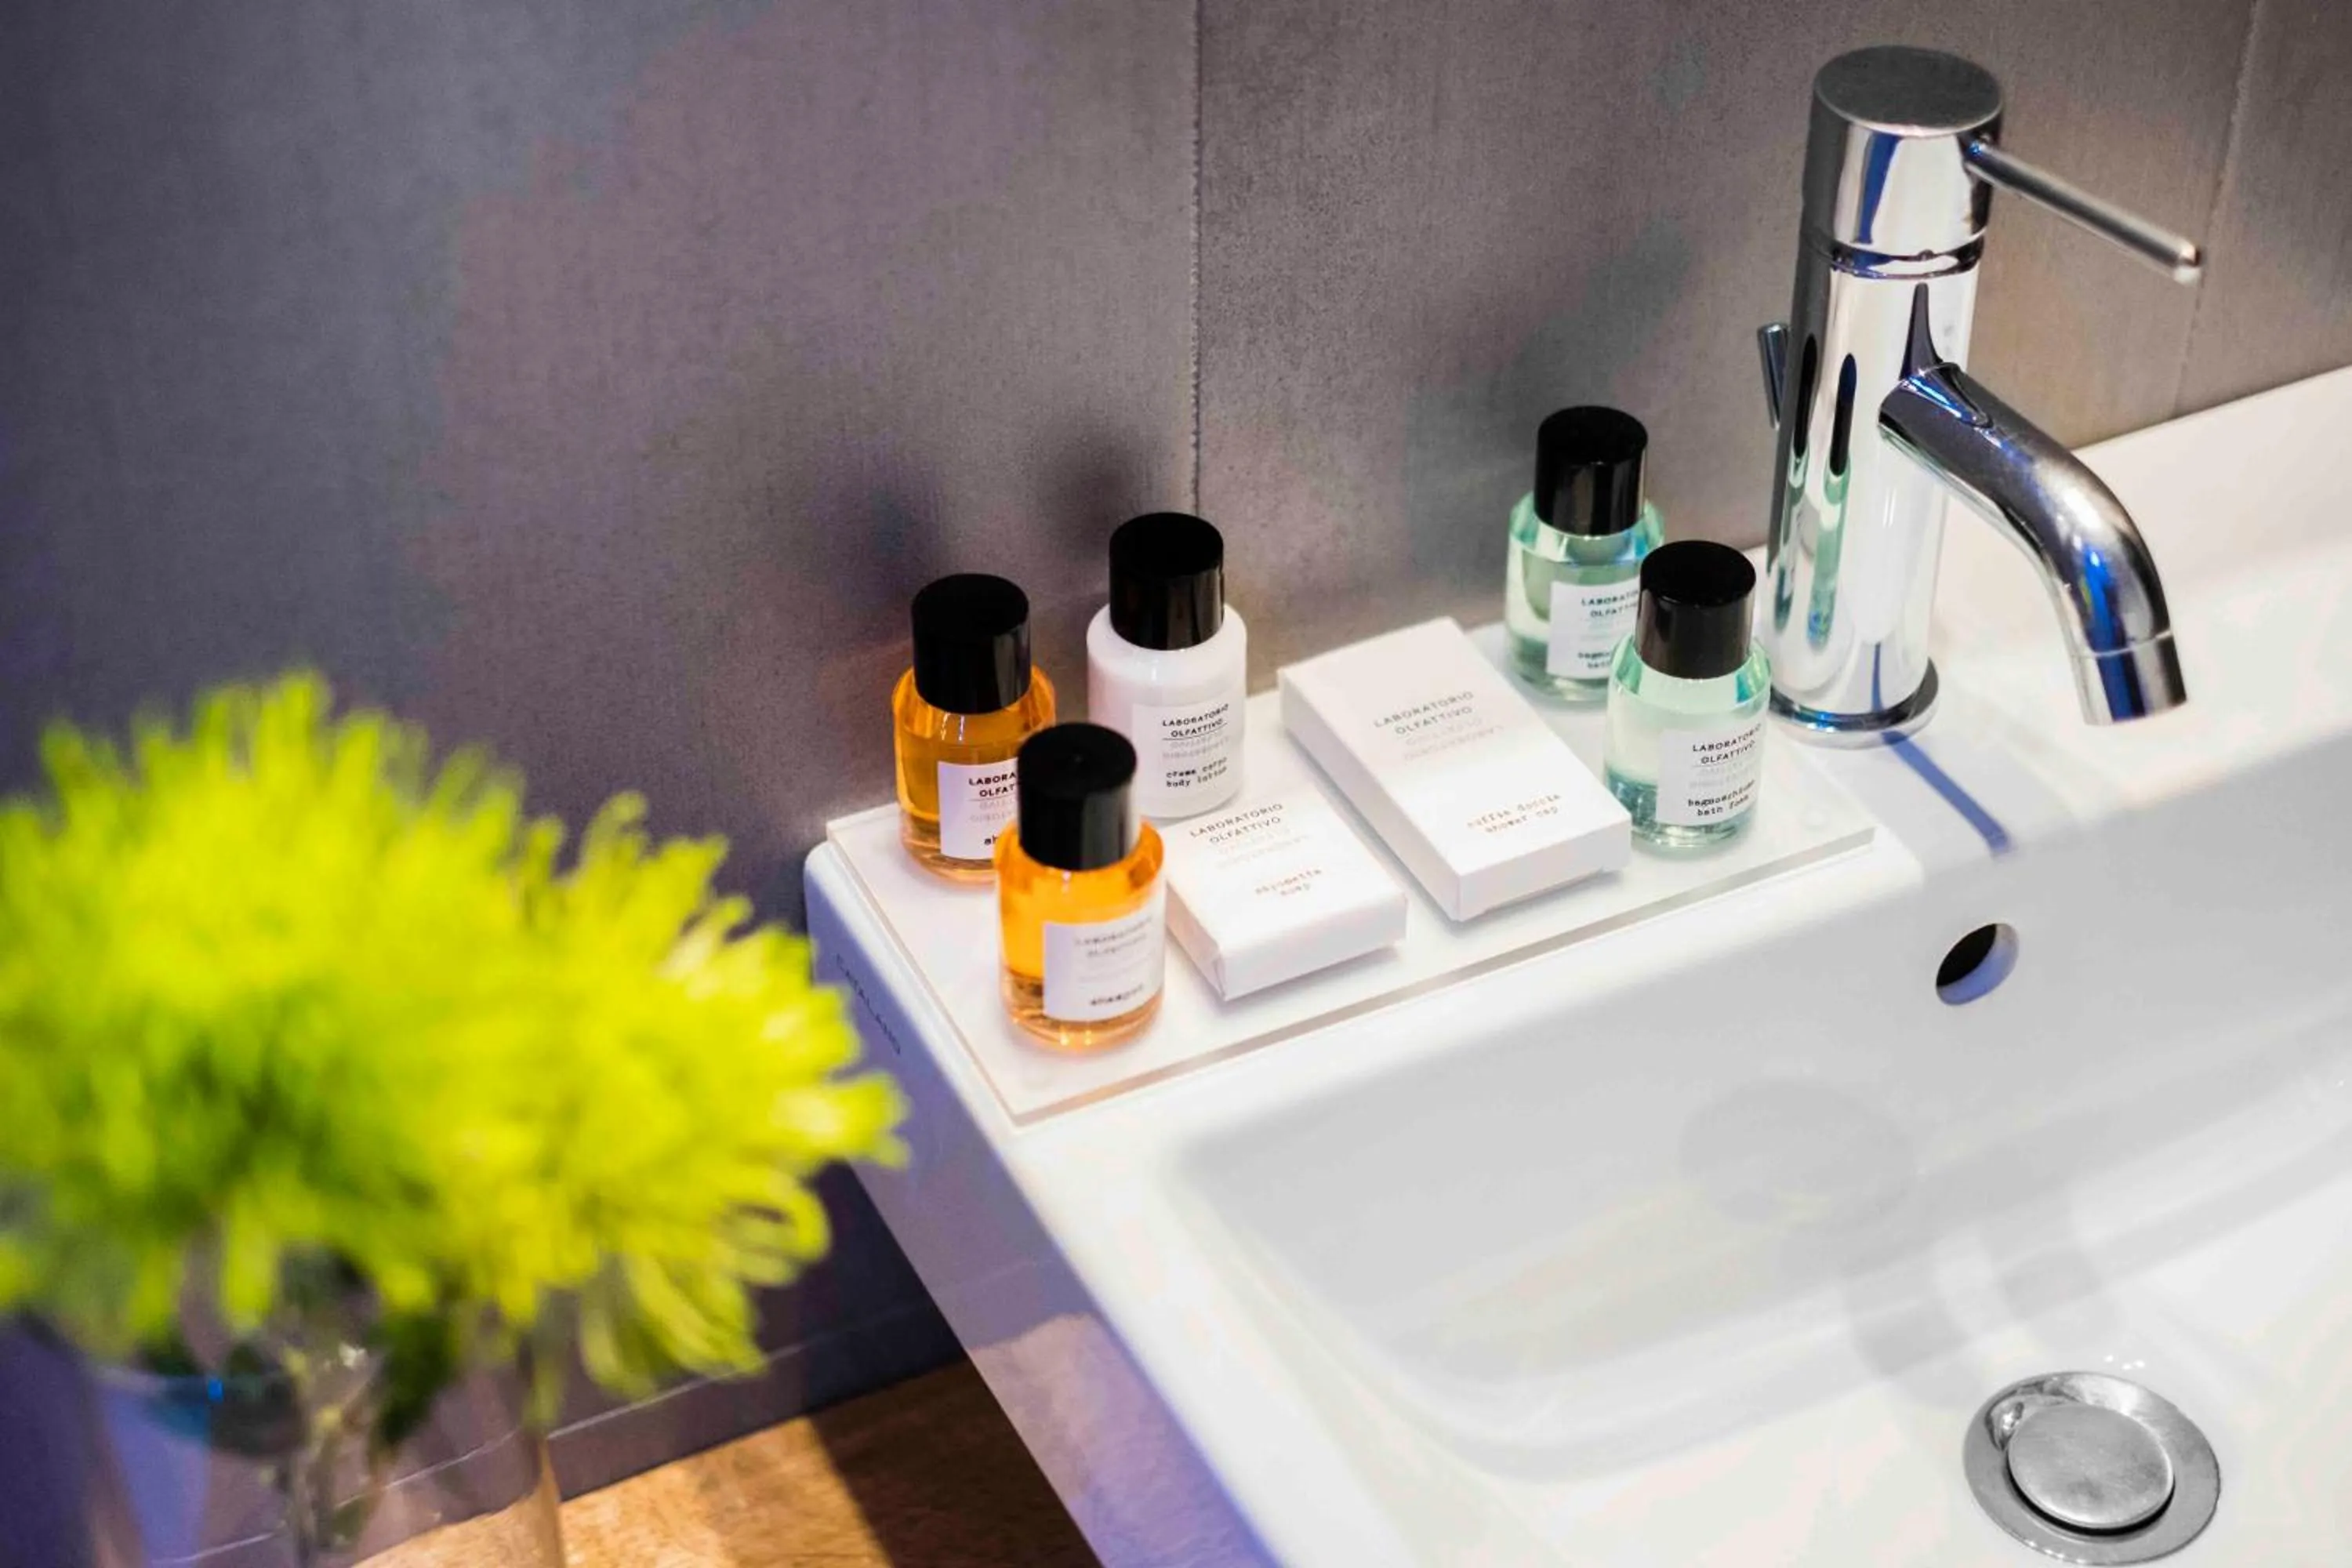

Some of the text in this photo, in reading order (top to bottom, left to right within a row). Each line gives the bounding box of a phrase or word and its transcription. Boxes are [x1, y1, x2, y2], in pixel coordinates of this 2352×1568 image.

[1163, 703, 1229, 726] LABORATORIO
[1374, 691, 1474, 728] LABORATORIO
[1395, 706, 1472, 735] OLFATTIVO
[1171, 718, 1224, 737] OLFATTIVO
[1693, 723, 1761, 752] LABORATORIO
[1700, 740, 1755, 764] OLFATTIVO
[968, 771, 1017, 786] LABORA
[979, 784, 1015, 797] OLFAT
[1166, 779, 1191, 788] body
[1189, 803, 1283, 838] LABORATORIO
[1209, 816, 1281, 844] OLFATTIVO
